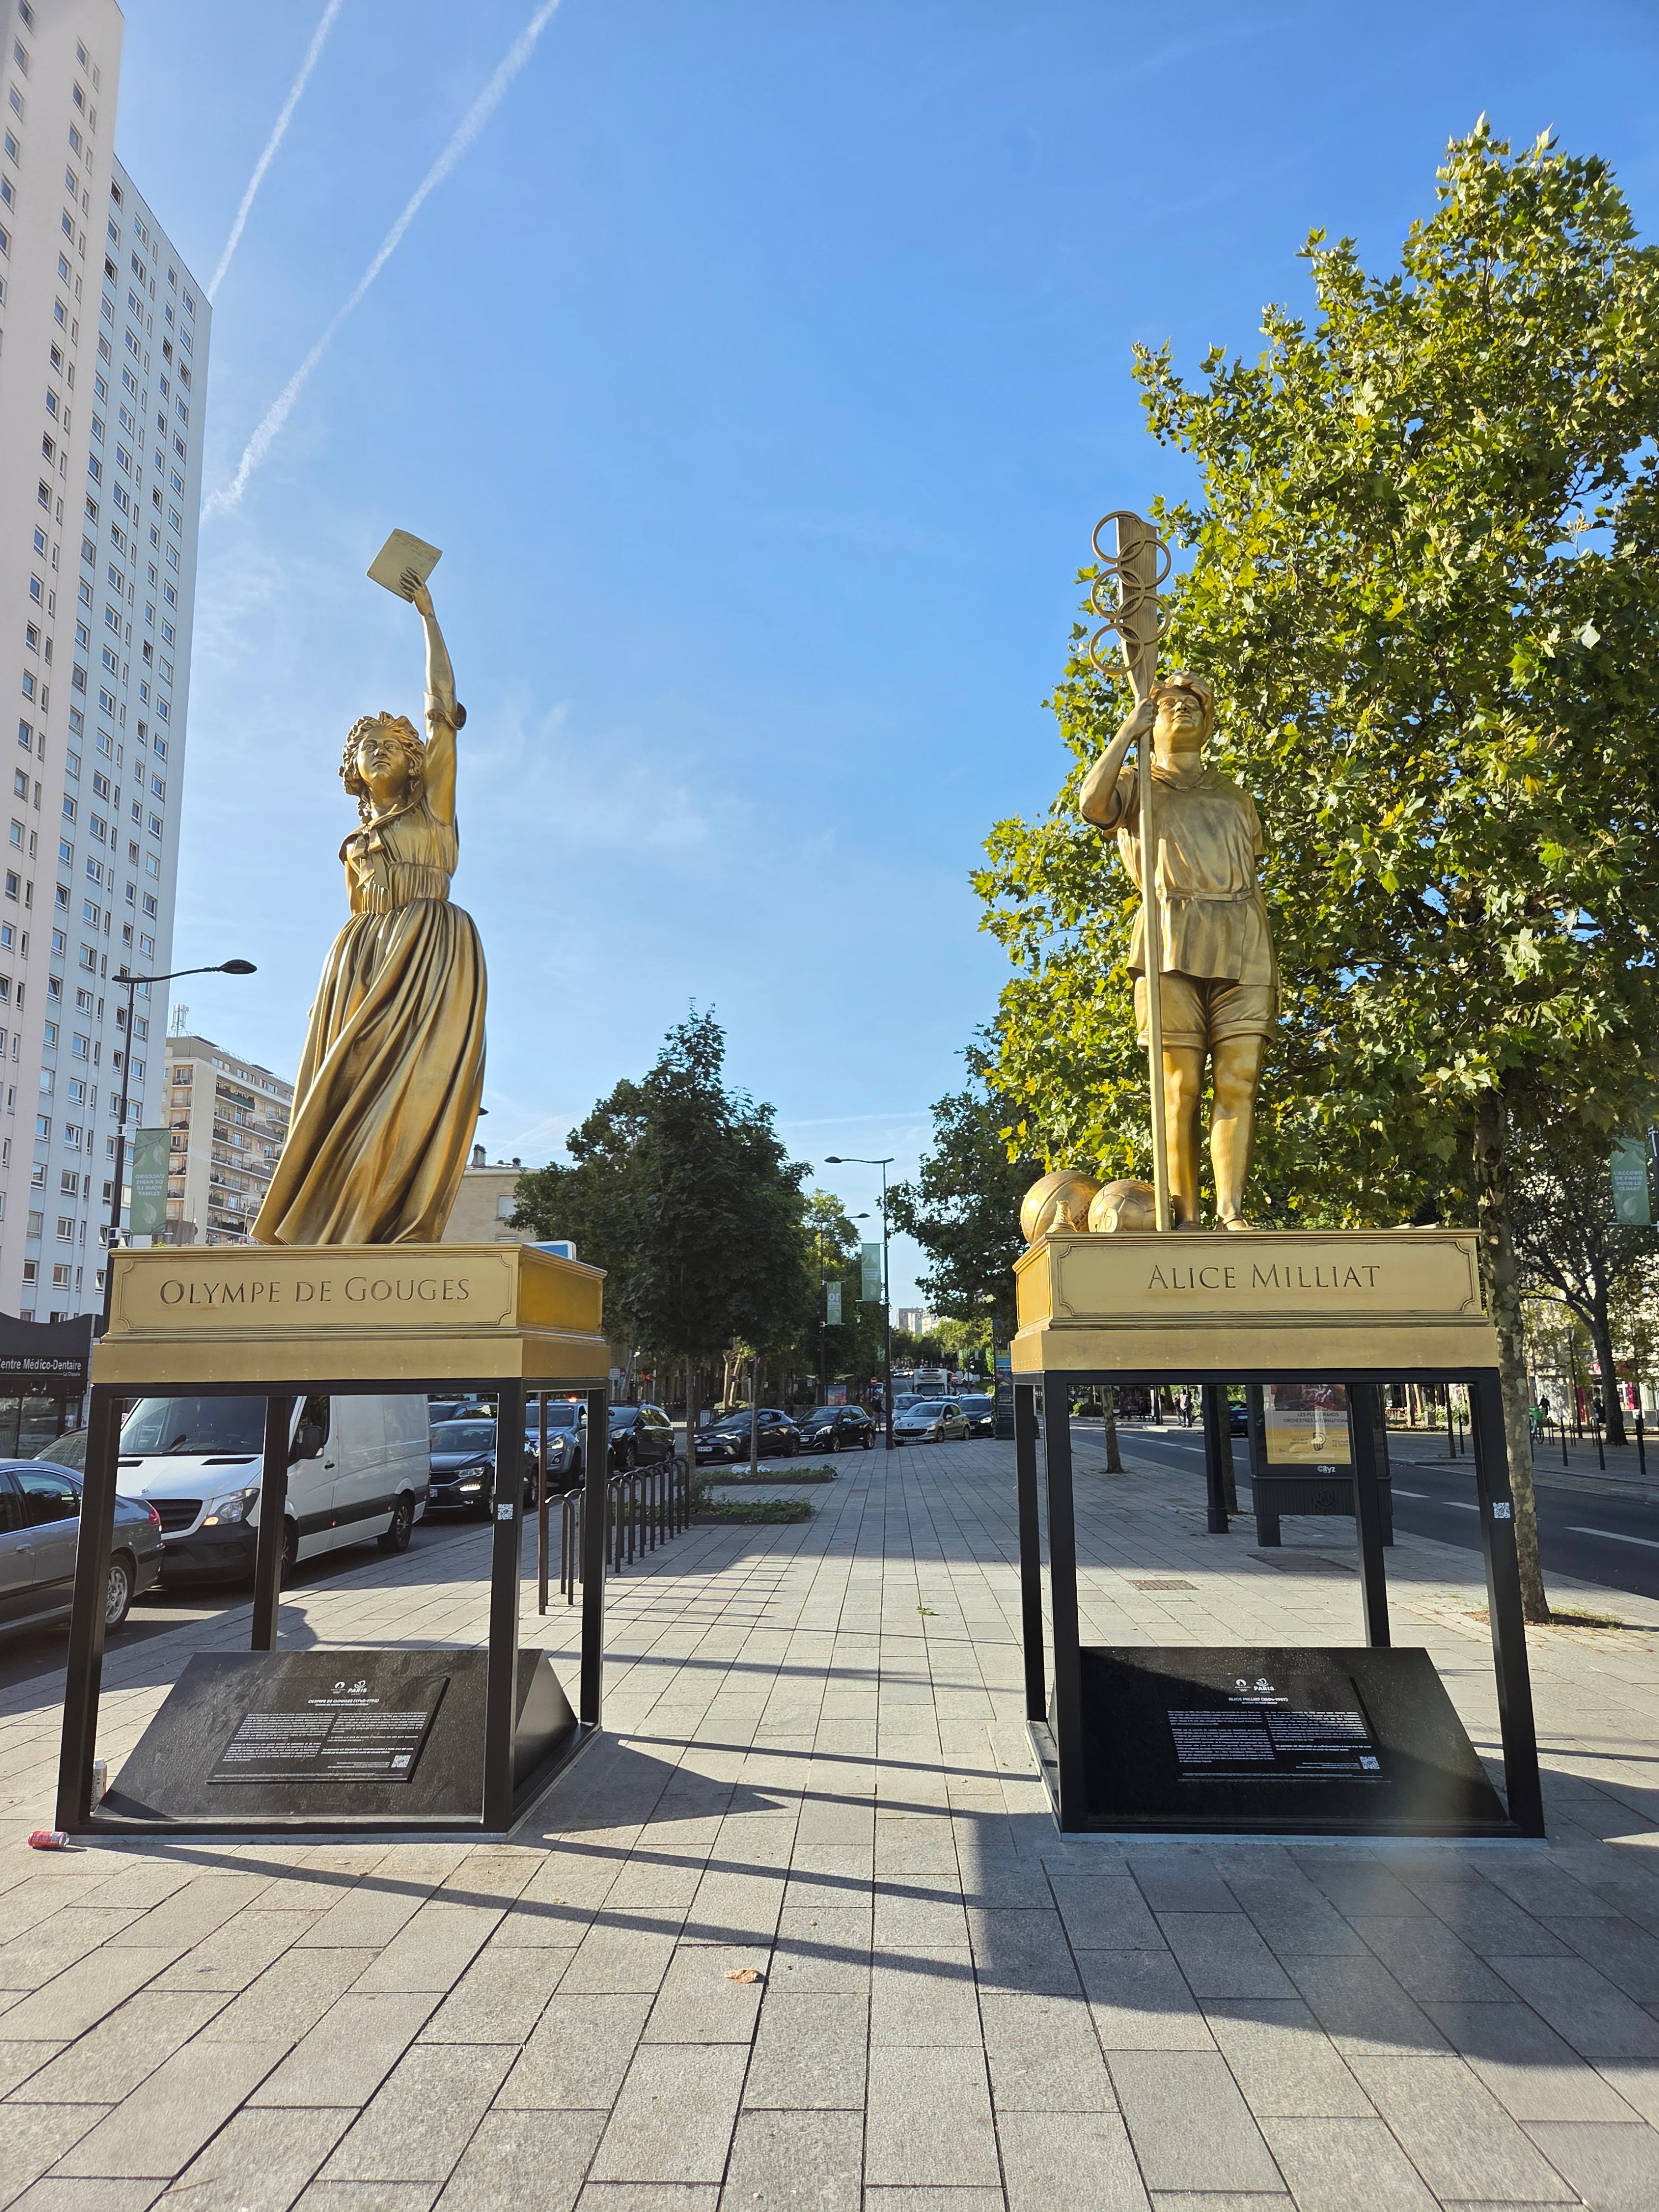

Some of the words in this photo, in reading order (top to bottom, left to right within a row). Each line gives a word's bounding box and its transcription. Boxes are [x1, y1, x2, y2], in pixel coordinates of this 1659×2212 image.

[1147, 1265, 1236, 1290] ALICE
[1252, 1263, 1380, 1288] MILLIAT
[160, 1279, 280, 1305] OLYMPE
[295, 1281, 331, 1302] DE
[345, 1276, 469, 1302] GOUGES
[23, 1358, 81, 1370] Médico-Dentaire
